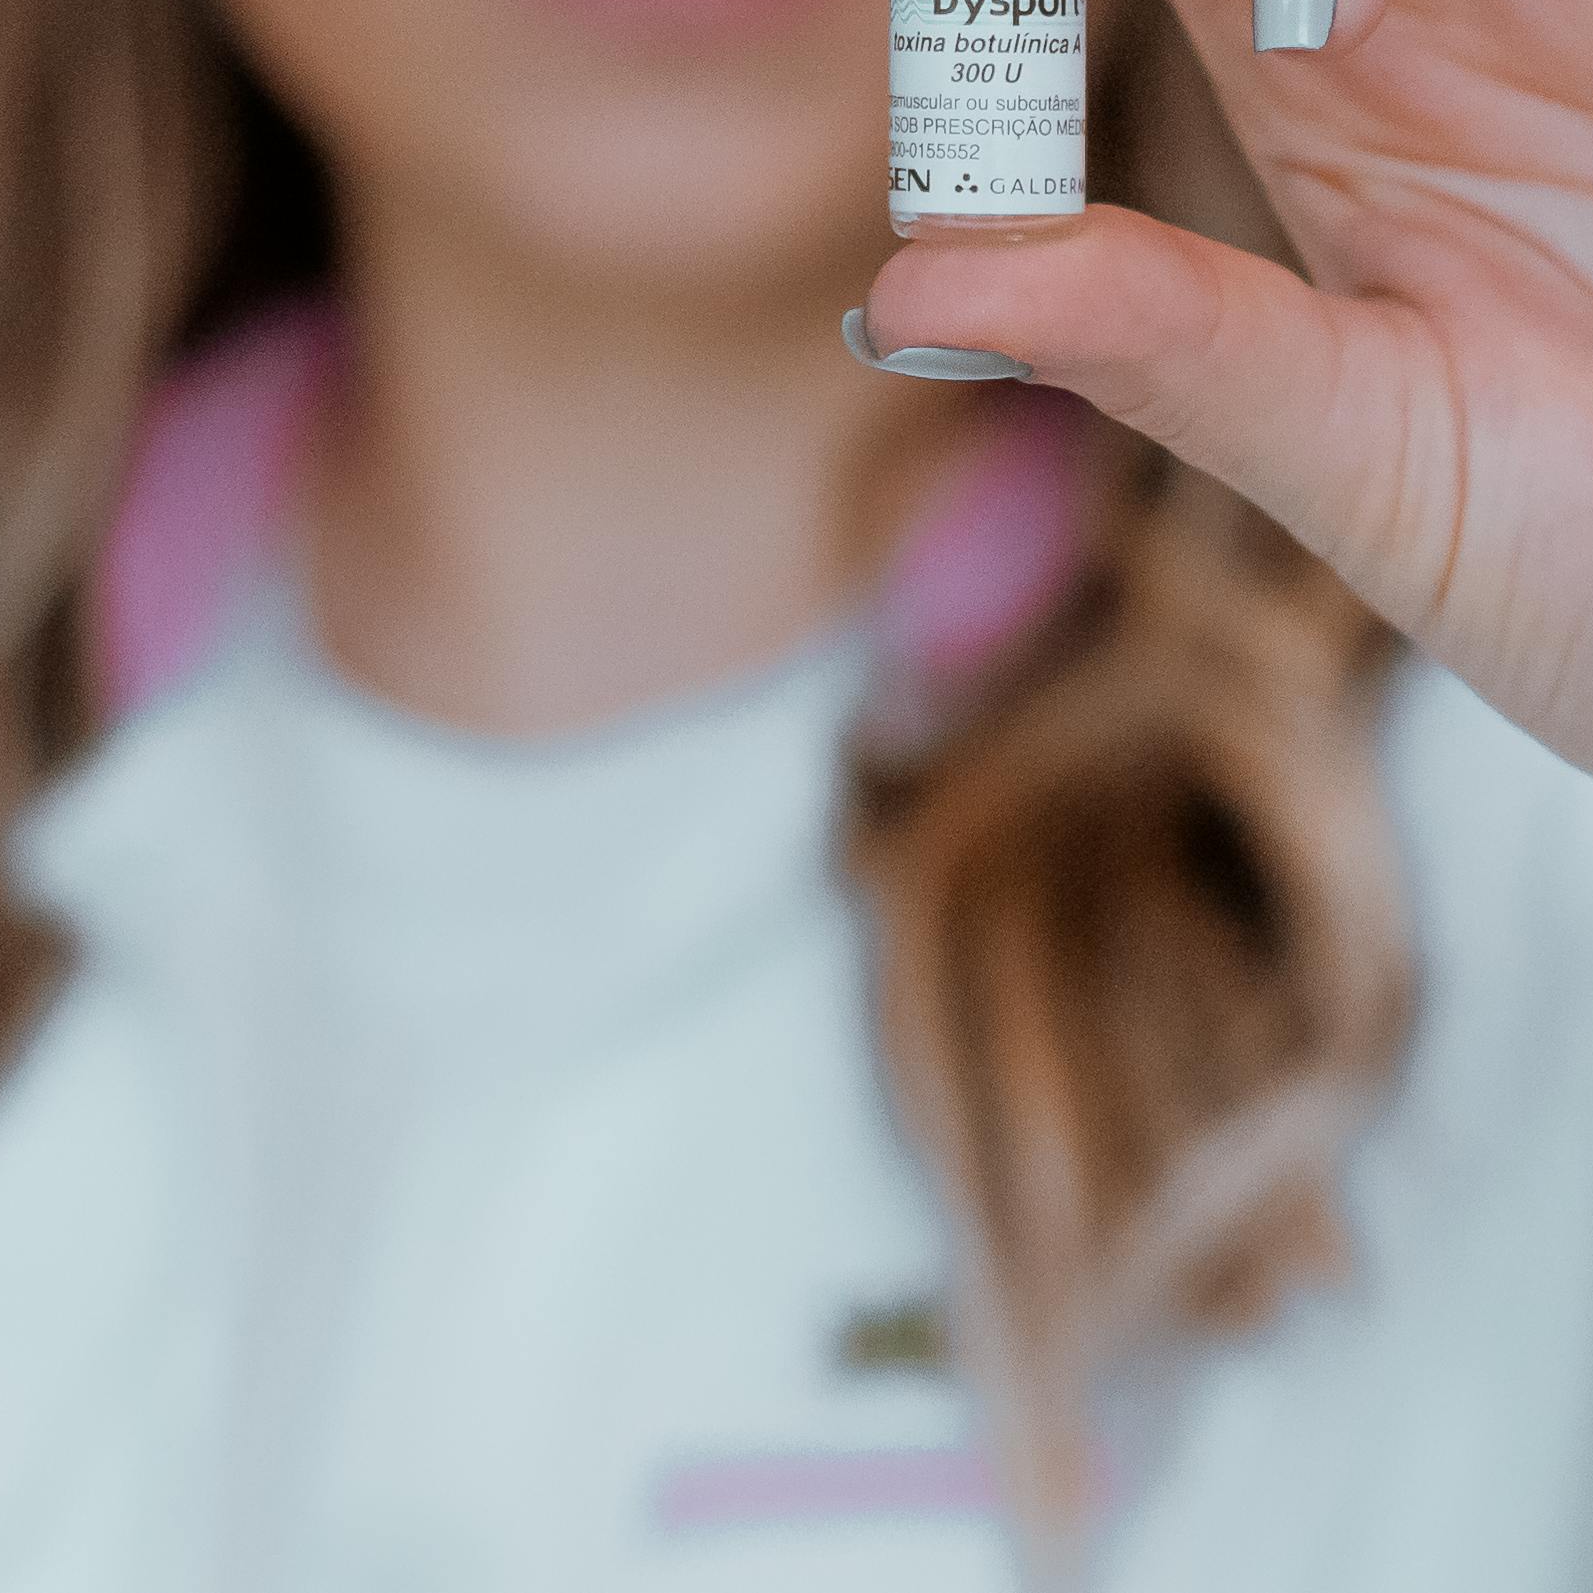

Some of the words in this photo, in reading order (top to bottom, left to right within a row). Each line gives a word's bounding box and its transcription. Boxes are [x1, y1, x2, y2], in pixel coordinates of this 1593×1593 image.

[893, 31, 946, 53] toxina
[954, 32, 1069, 55] botulínica
[1072, 34, 1082, 55] A
[951, 63, 996, 83] 300
[1005, 63, 1023, 83] U
[966, 97, 989, 111] ou
[893, 116, 919, 134] SOB
[923, 116, 1052, 140] PRESCRIÇÃO
